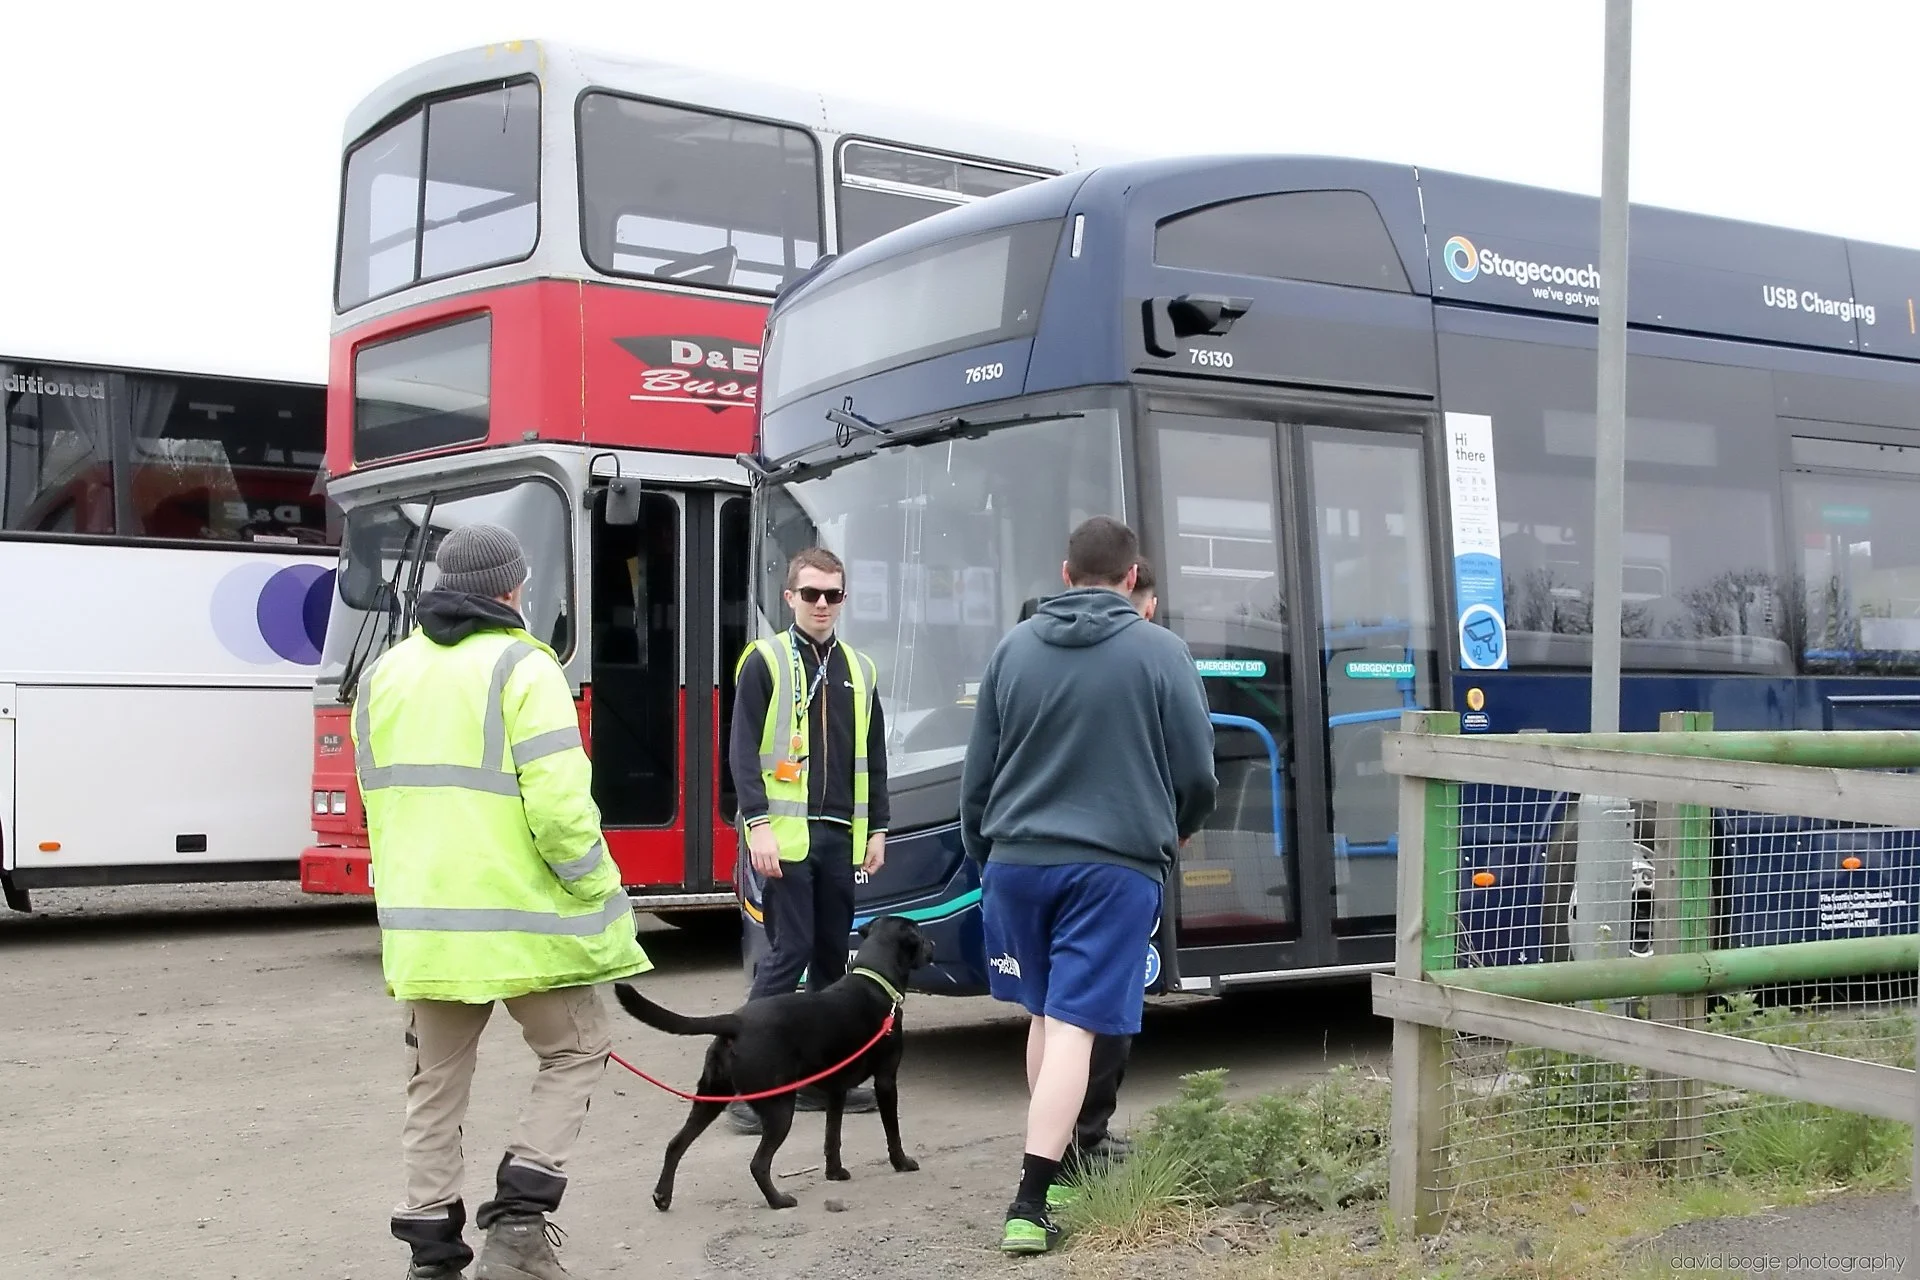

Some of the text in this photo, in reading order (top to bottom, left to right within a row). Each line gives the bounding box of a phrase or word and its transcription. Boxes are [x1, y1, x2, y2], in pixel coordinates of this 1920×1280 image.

[1479, 249, 1600, 289] Stagecoach
[1532, 287, 1564, 300] we've
[1565, 290, 1582, 305] got
[1763, 285, 1876, 325] USB Charging
[1189, 349, 1233, 368] 76130
[641, 368, 757, 398] Buse
[965, 363, 1003, 384] 76130
[0, 374, 105, 399] ditioned
[1455, 432, 1467, 446] Hi
[1456, 447, 1485, 462] there
[1196, 661, 1262, 671] EMERGENCY EXIT
[1349, 663, 1412, 673] EMERGENCY EXIT
